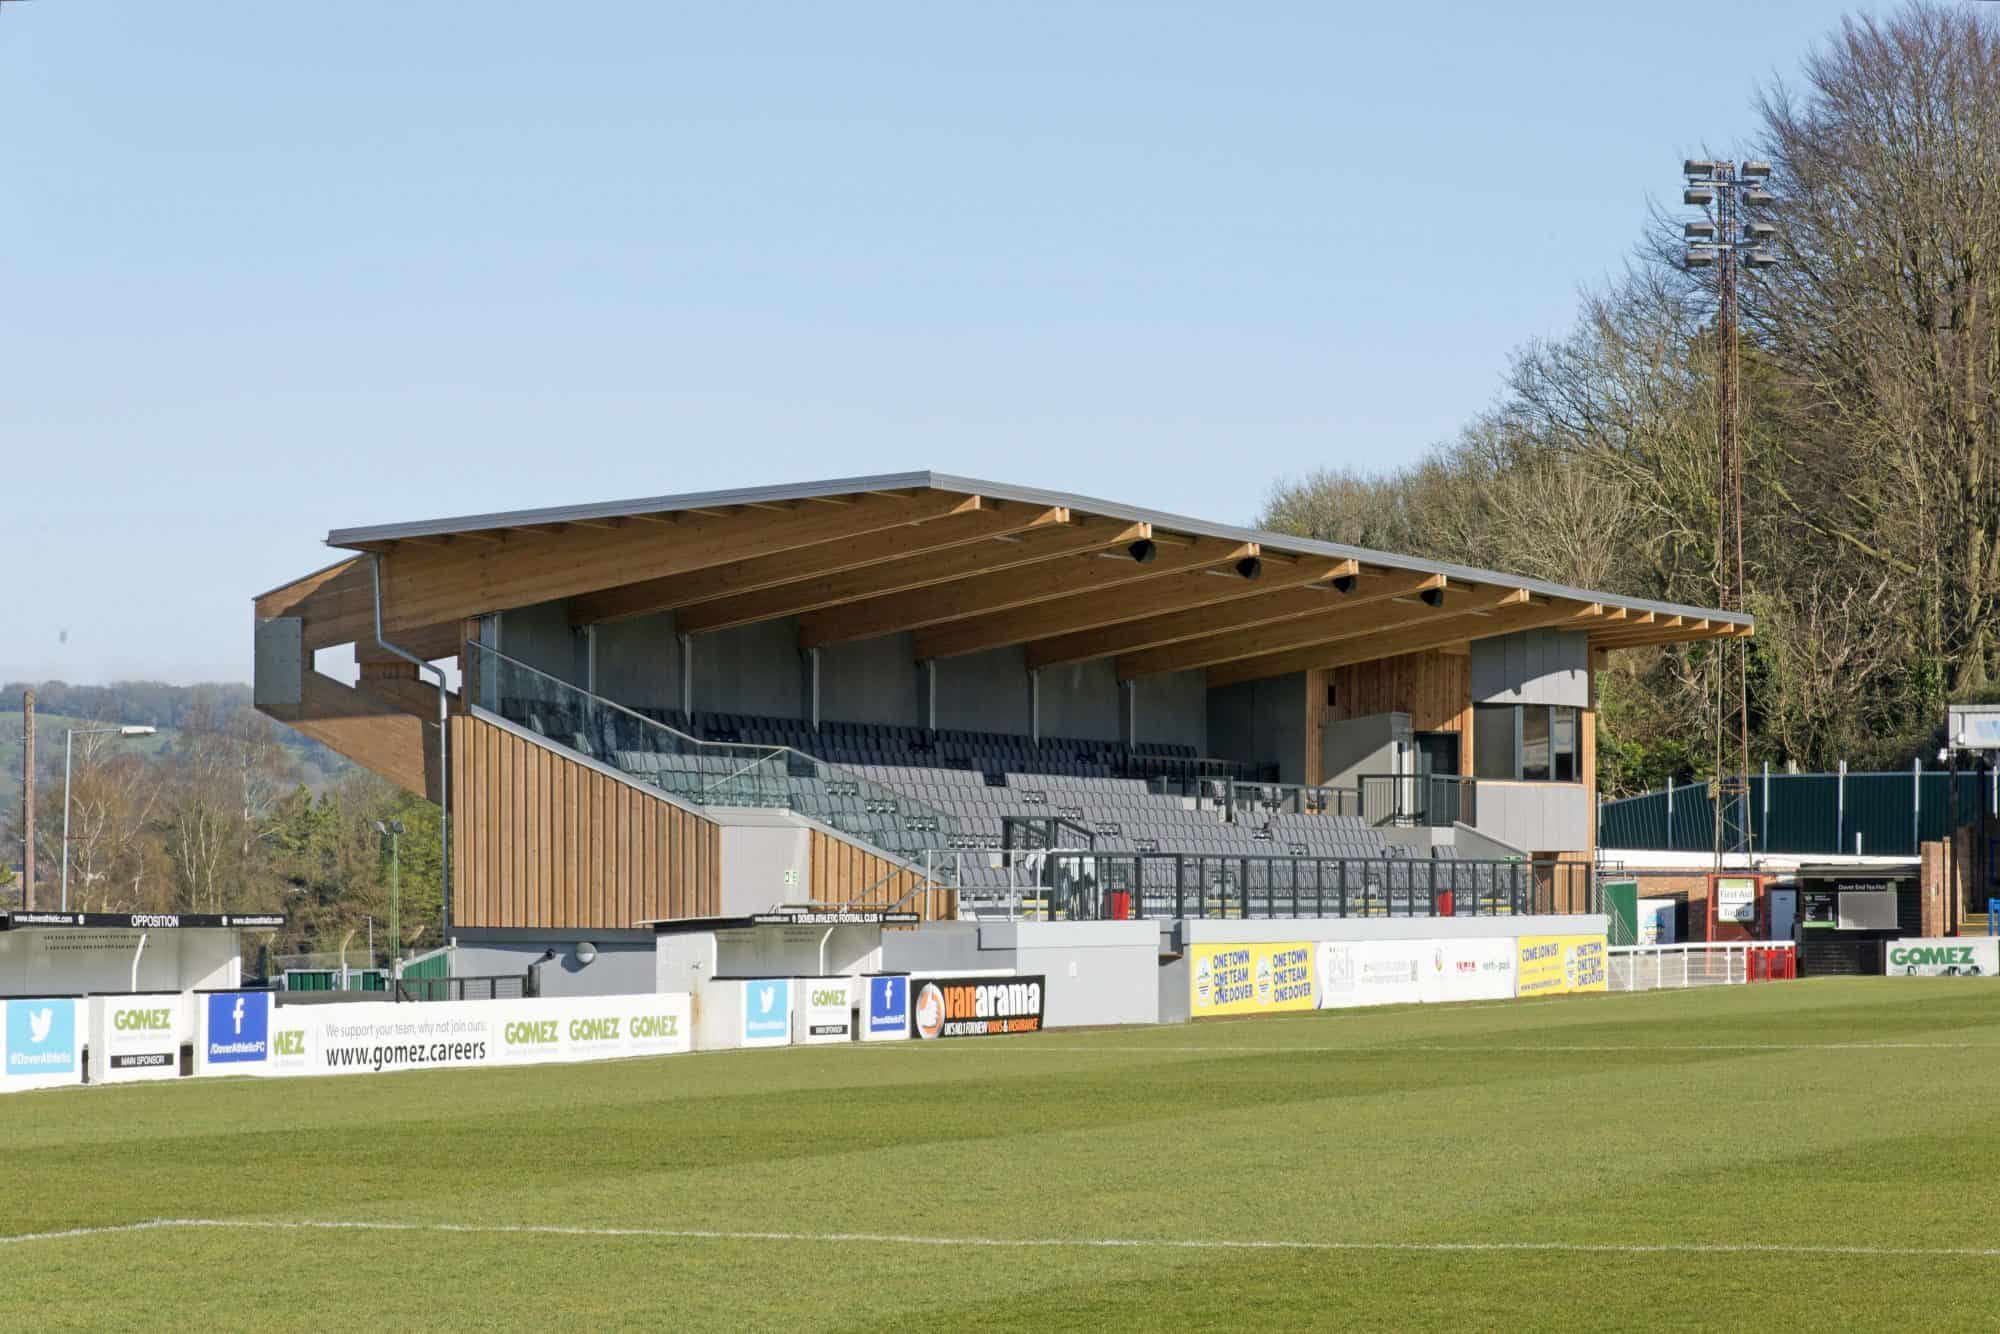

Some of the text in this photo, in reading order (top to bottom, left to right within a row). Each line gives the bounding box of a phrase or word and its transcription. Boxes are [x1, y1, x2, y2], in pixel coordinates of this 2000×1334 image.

[131, 915, 179, 927] OPPOSITION
[815, 914, 838, 923] ATHLETIC
[839, 913, 864, 923] FOOTBALL
[864, 913, 877, 922] CLUB
[1273, 949, 1308, 968] ONE TOWN
[1522, 946, 1537, 961] COME
[1538, 944, 1549, 960] JOIN
[1577, 942, 1602, 957] ONE TOWN
[1890, 947, 1975, 965] GOMEZ
[1213, 950, 1250, 969] ONE TOWN
[1578, 956, 1601, 971] ONE TEAM
[1214, 968, 1249, 987] ONE TEAM
[1273, 966, 1307, 985] ONE TEAM
[1578, 973, 1587, 986] ONE
[812, 990, 846, 1007] GOMEZ
[944, 983, 1040, 1019] vanarama
[1214, 983, 1253, 1005] ONE DOVER
[1274, 987, 1288, 1002] ONE
[1288, 982, 1311, 999] DOVER
[114, 1008, 171, 1030] GOMEZ
[1003, 1019, 1008, 1032] &
[326, 1024, 338, 1038] We
[340, 1023, 373, 1040] support
[375, 1023, 394, 1039] your
[418, 1021, 434, 1035] why
[435, 1021, 450, 1033] not
[450, 1020, 466, 1034] join
[505, 1015, 678, 1044] GOMEZ GOMEZ GOMEZ
[121, 1055, 165, 1066] MAIN SPONSOR
[326, 1041, 486, 1071] www.gomez.careers
